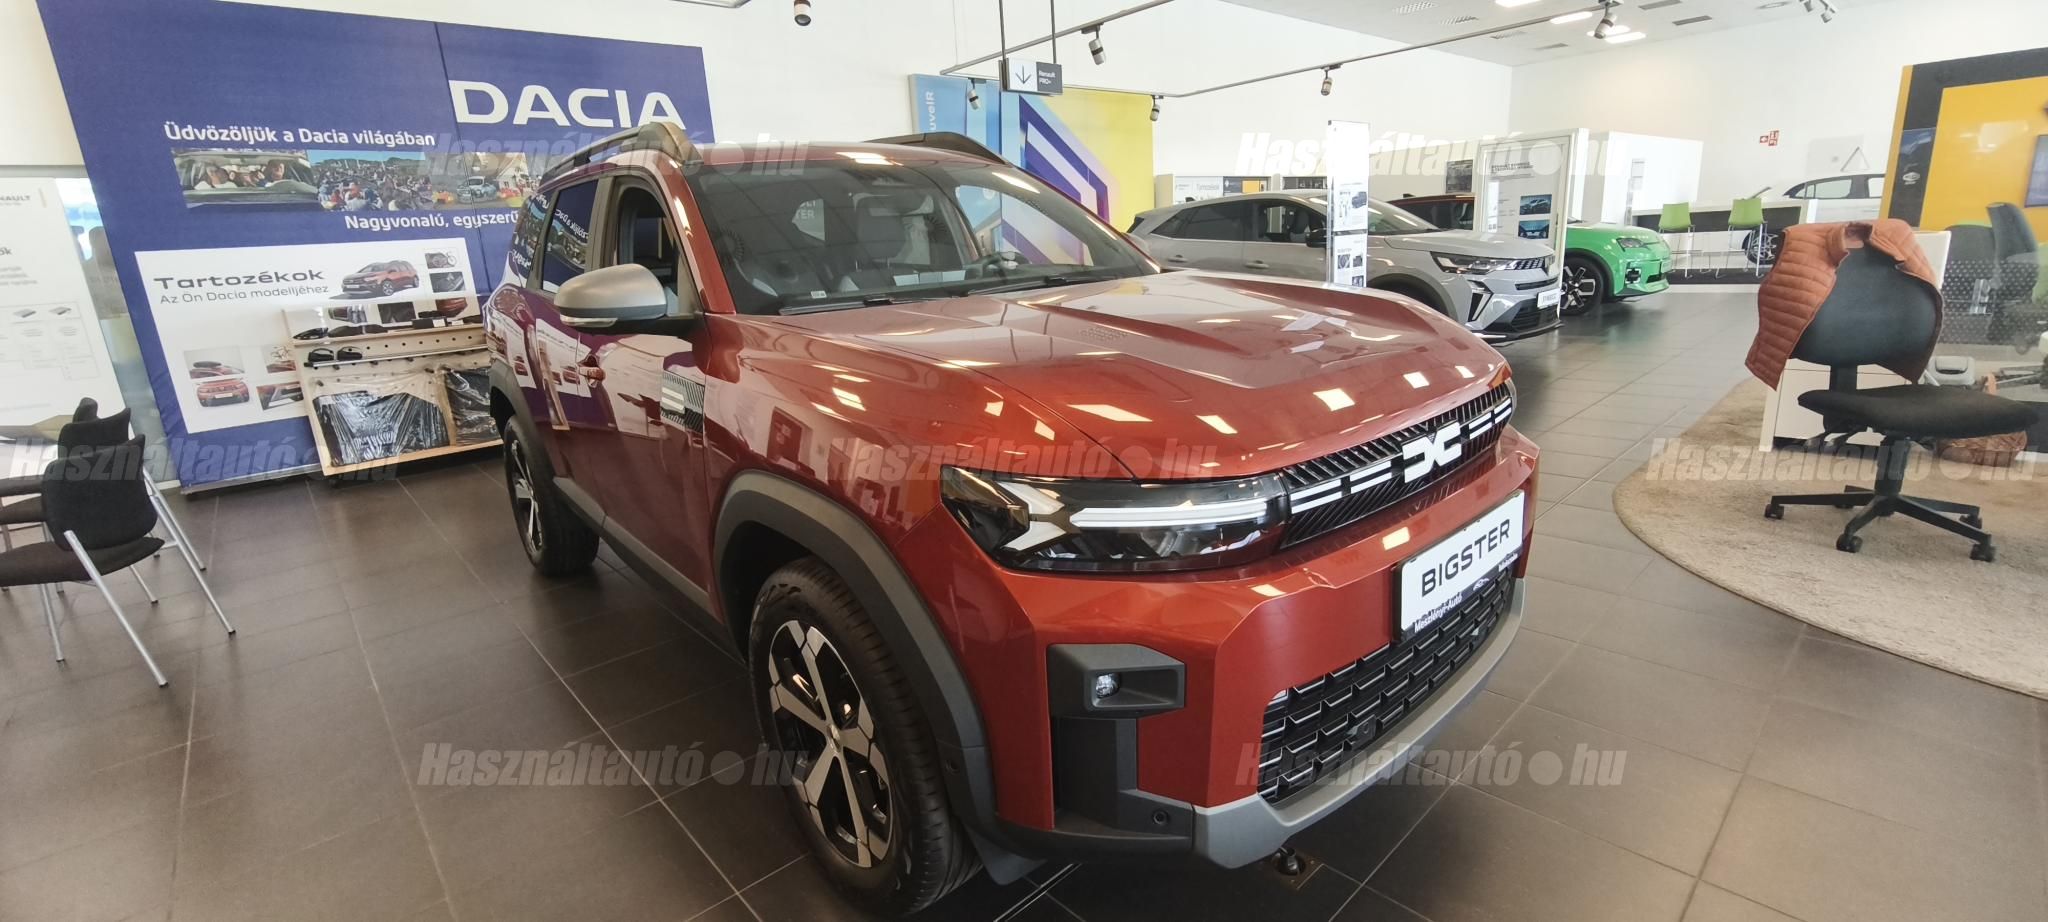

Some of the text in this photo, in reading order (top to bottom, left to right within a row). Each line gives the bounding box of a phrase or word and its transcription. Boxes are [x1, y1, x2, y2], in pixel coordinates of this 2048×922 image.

[448, 79, 686, 131] DACIA
[164, 121, 435, 148] Üdvözöljük a Dacia világában
[345, 213, 449, 232] Nagyvonalú,
[153, 269, 325, 289] Tartozékok
[160, 295, 178, 304] Az
[206, 290, 247, 301] Dacia
[250, 284, 329, 299] modelljéhez
[1421, 518, 1510, 598] BIGSTER
